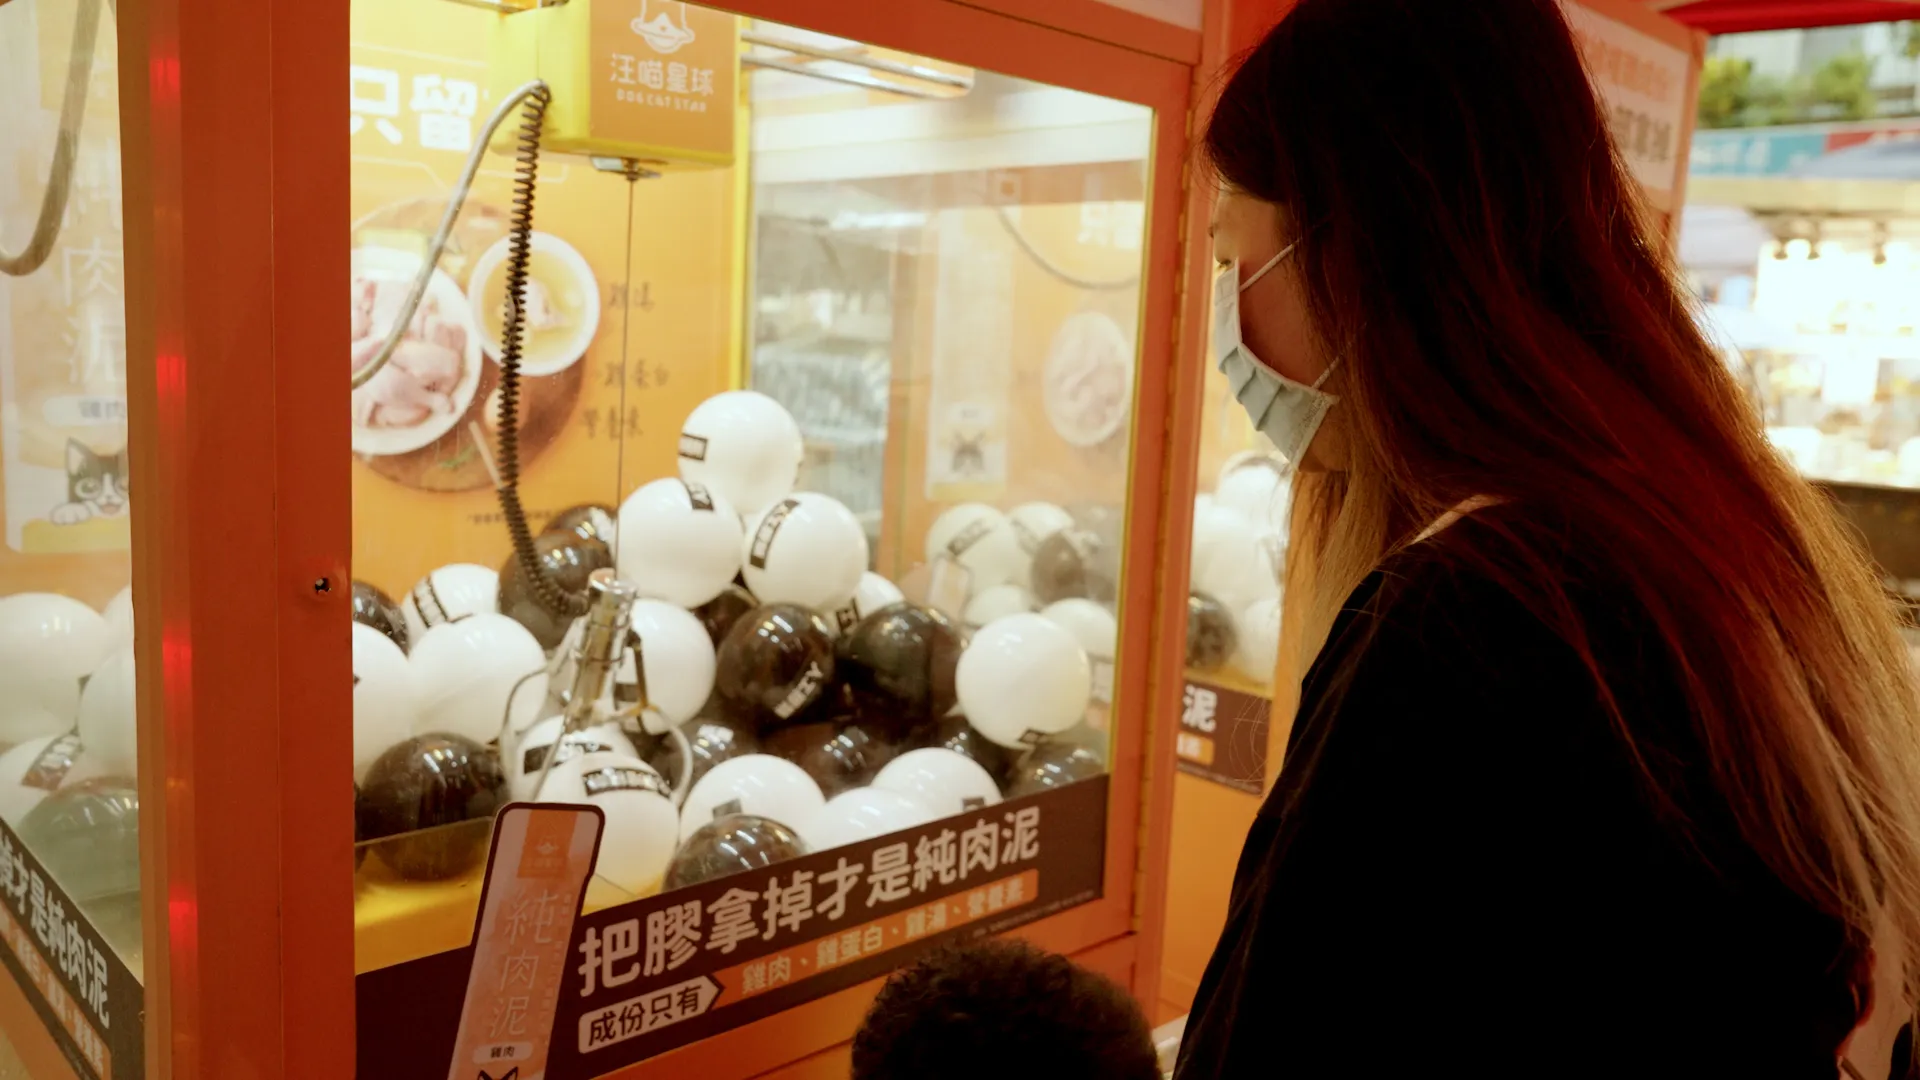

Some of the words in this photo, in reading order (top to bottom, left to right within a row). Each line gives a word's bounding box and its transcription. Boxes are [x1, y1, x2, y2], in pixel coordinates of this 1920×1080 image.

[350, 64, 478, 152] 只留
[609, 52, 714, 97] 汪喵星球
[577, 806, 1040, 998] 把膠拿掉才是純肉泥
[489, 889, 560, 1040] 純肉泥
[587, 984, 702, 1047] 成份只有
